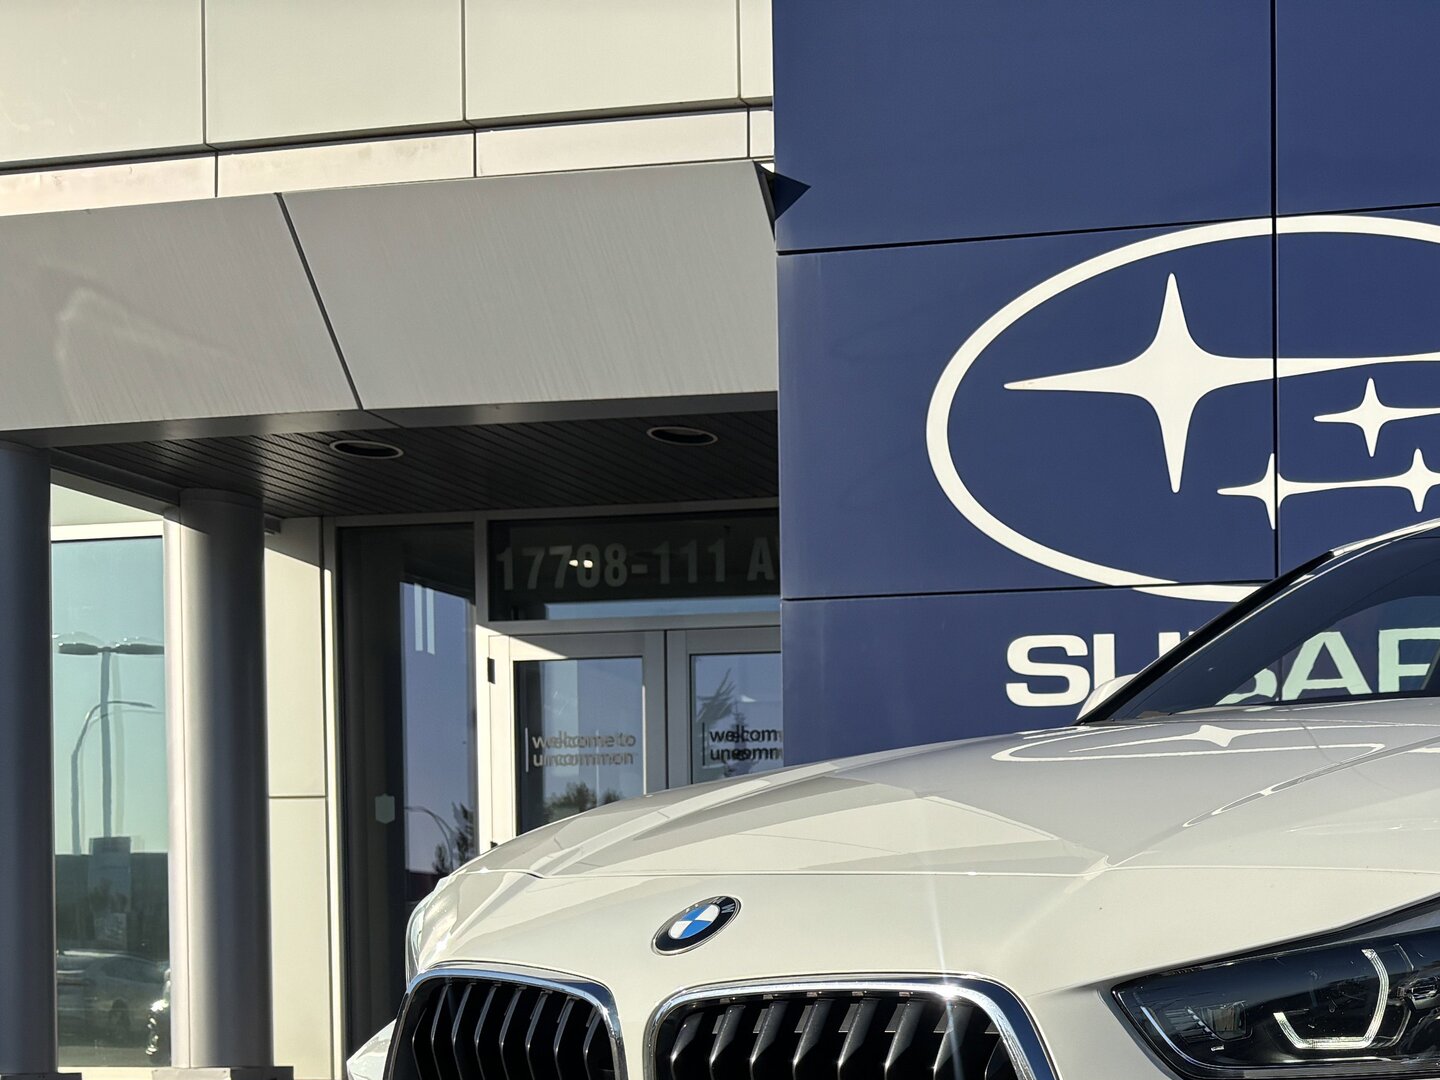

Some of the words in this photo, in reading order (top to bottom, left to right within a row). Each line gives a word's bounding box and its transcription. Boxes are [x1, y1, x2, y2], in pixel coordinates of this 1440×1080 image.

[746, 536, 779, 582] A
[532, 730, 613, 749] welcome
[616, 732, 636, 747] to
[532, 752, 634, 767] uncommon
